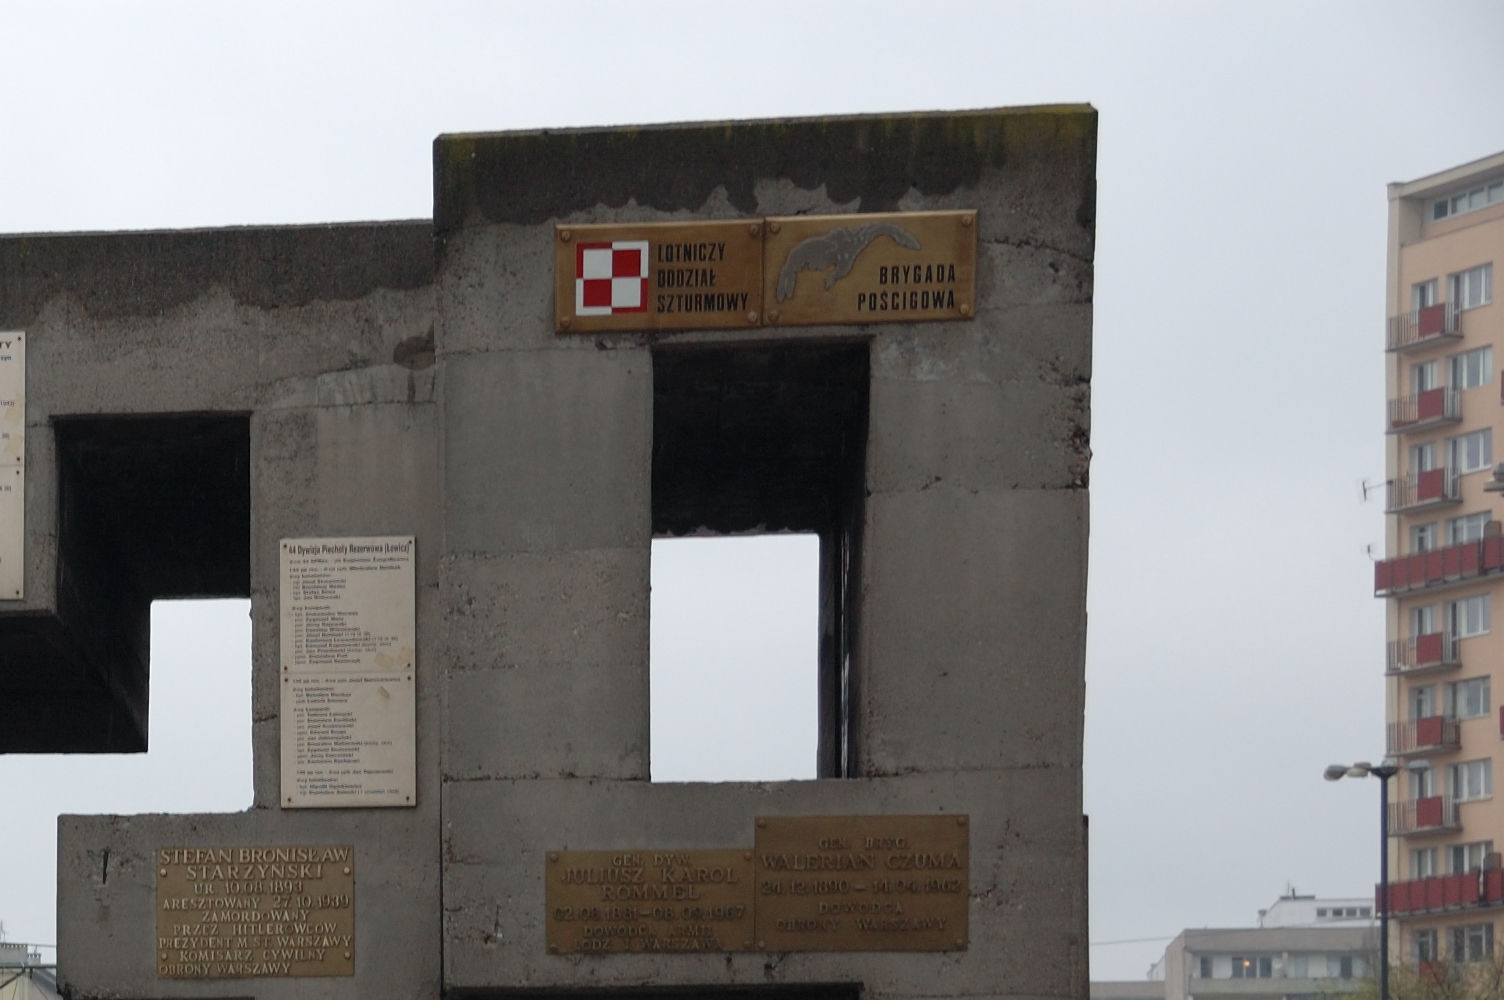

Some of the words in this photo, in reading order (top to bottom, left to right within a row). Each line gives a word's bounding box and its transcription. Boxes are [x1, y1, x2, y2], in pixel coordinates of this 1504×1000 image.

[657, 243, 726, 264] LOTNICZY
[657, 268, 717, 289] ODDZIAŁ
[879, 263, 957, 286] BRYGADA
[657, 292, 749, 313] SZTURMOWY
[857, 288, 956, 313] POŚCIGOWA
[160, 848, 232, 864] STEFAN
[239, 848, 349, 863] BRONISŁAW
[761, 854, 874, 872] WALERIAN
[886, 853, 961, 870] CZUMA
[562, 868, 645, 884] JULIUSZ
[661, 867, 738, 883] KAROL
[163, 897, 260, 911] ARESZTOWANY
[202, 910, 310, 923] ZAMORDOWANY
[173, 923, 219, 936] PRZEZ
[159, 937, 232, 949] PREZYDENT
[277, 936, 352, 948] WARSZAWY
[180, 950, 253, 961] KOMISARZ
[263, 949, 325, 961] CYWILNY
[159, 964, 211, 975] OBRONY
[217, 963, 291, 975] WARSZAWY
